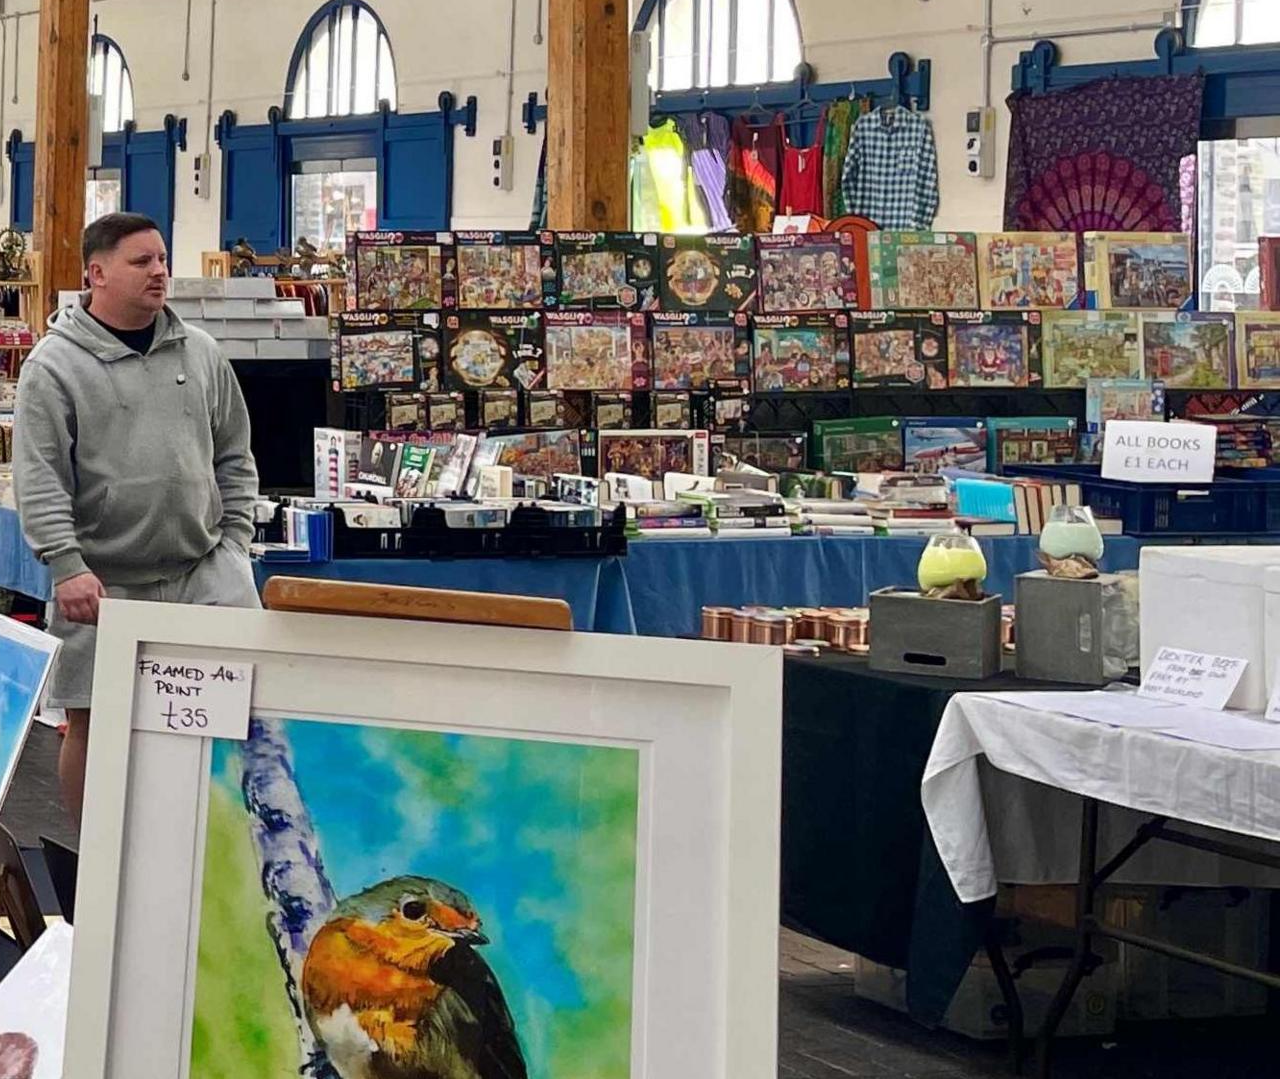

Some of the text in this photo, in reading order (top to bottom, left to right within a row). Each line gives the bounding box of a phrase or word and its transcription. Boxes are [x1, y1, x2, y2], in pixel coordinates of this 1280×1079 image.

[1116, 435, 1201, 451] ALL BOOKS
[1124, 456, 1189, 471] £1 EACH
[138, 660, 204, 681] FRAMED
[155, 680, 202, 696] PRINT
[160, 701, 208, 730] £35
